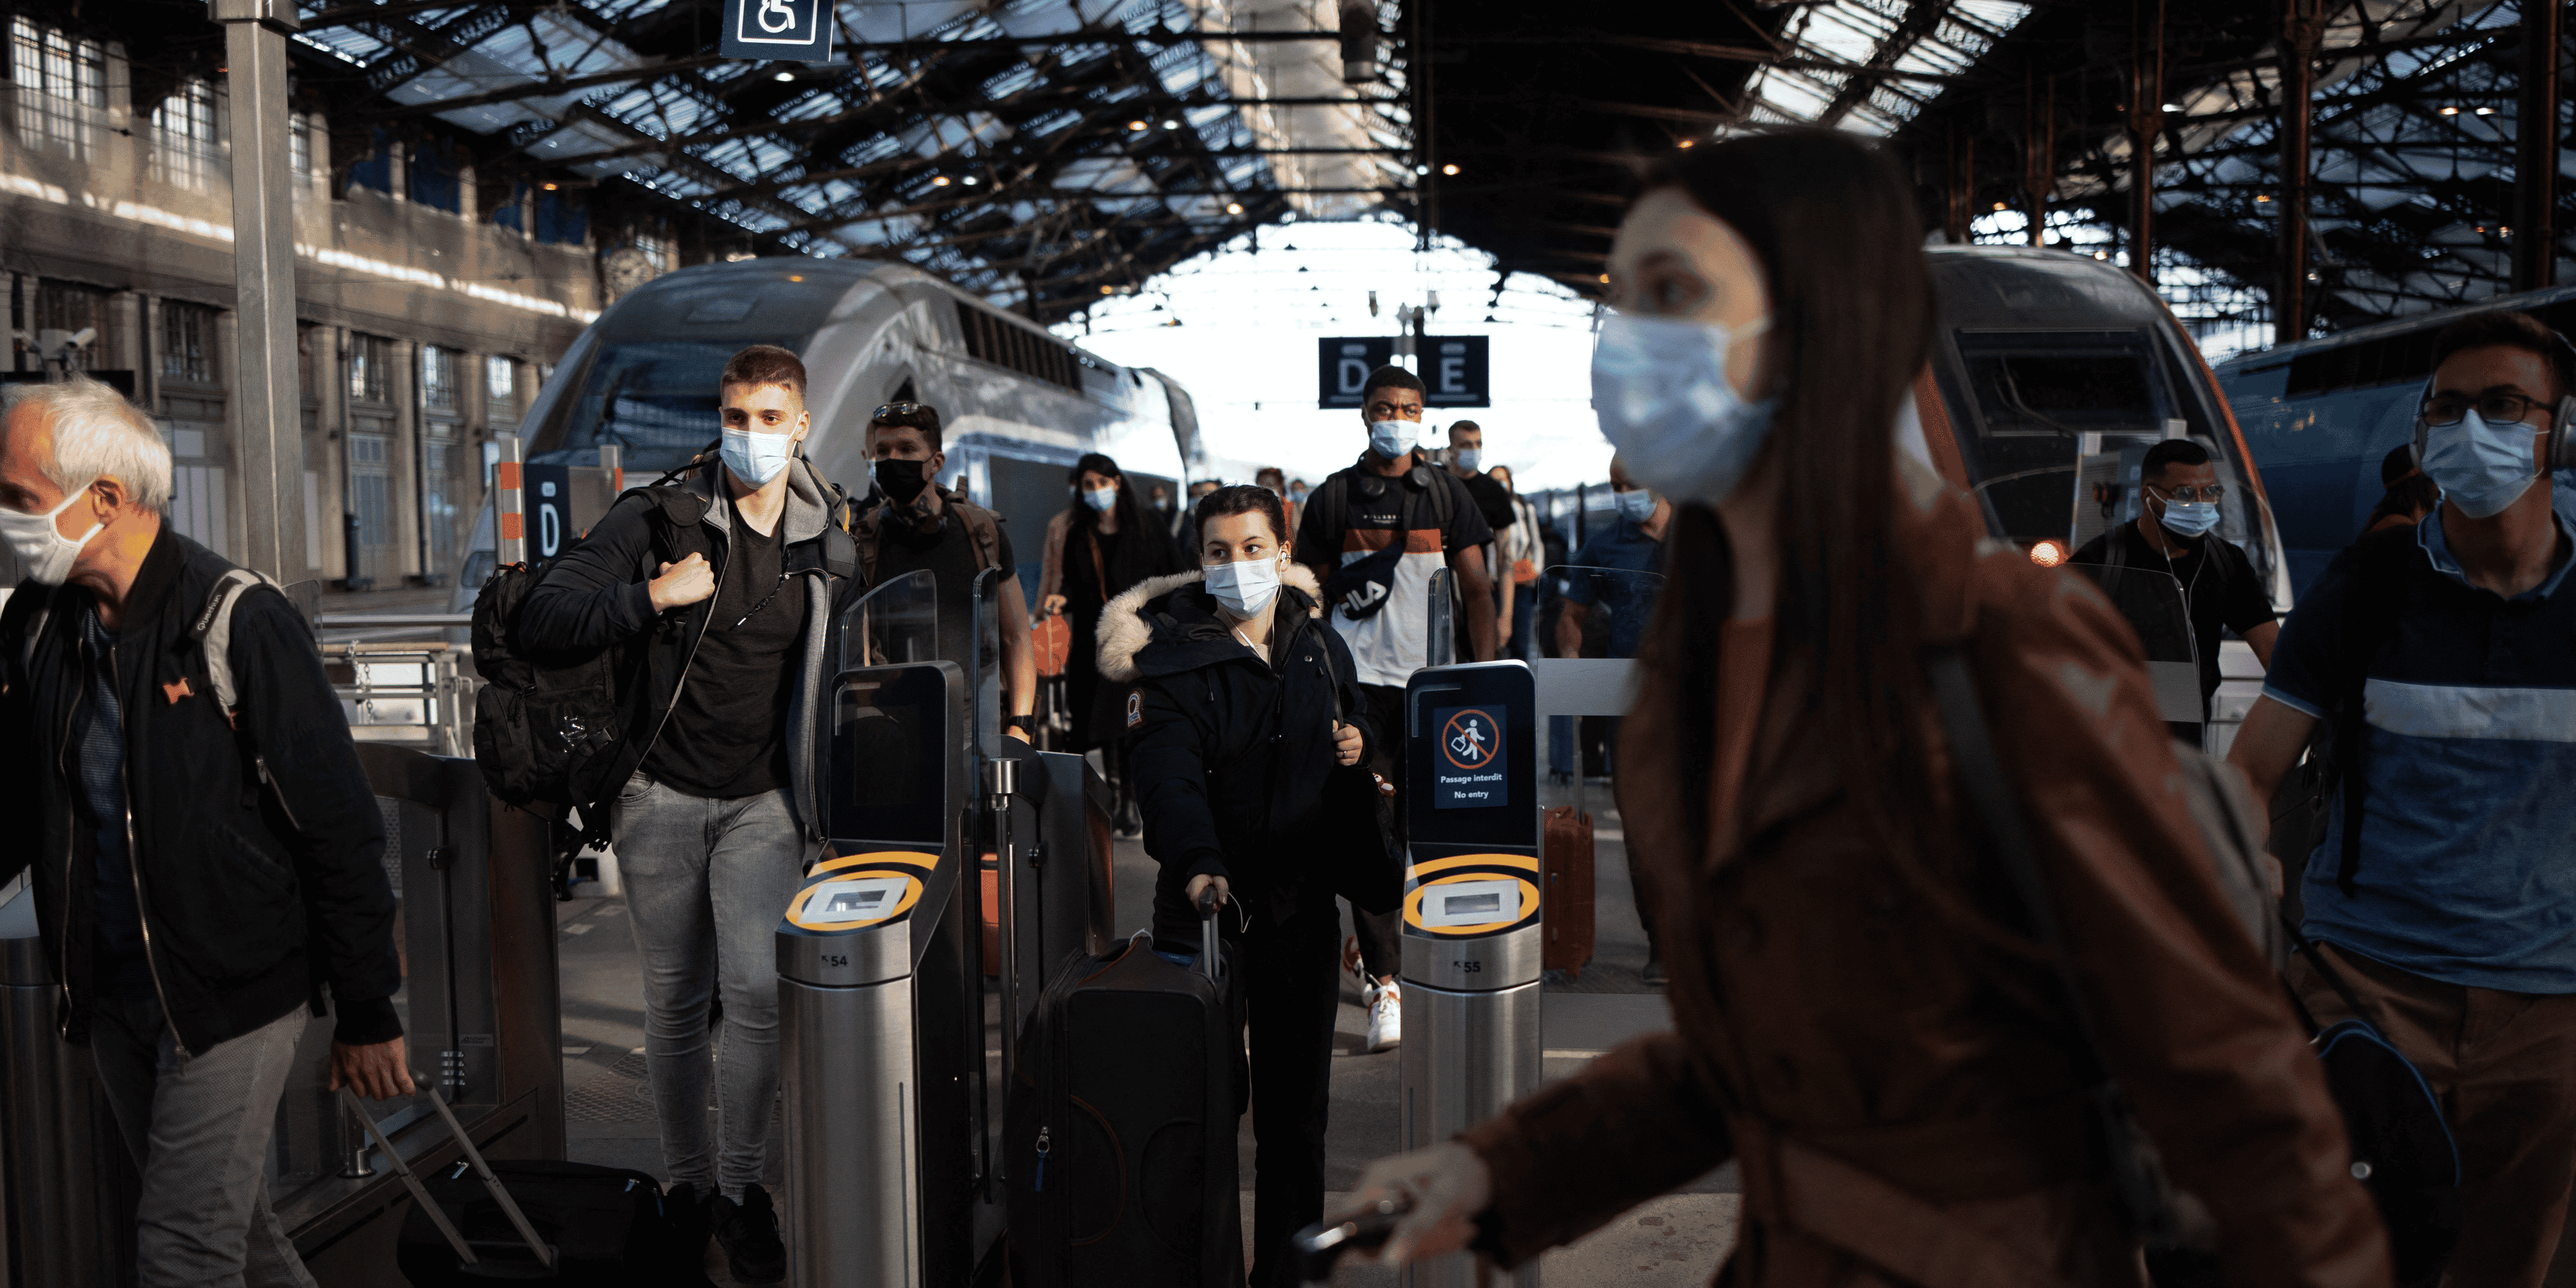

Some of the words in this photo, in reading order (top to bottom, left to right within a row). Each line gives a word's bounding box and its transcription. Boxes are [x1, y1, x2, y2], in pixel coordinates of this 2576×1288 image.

[1338, 358, 1371, 394] D
[1440, 356, 1467, 394] E
[540, 503, 560, 557] D
[196, 594, 222, 631] Quechua
[1338, 580, 1387, 617] FILA
[1440, 775, 1472, 785] Passage
[1473, 773, 1503, 782] interdit
[1454, 791, 1467, 799] No
[1468, 791, 1489, 800] entry
[831, 955, 848, 967] 54
[1464, 961, 1481, 973] 55
